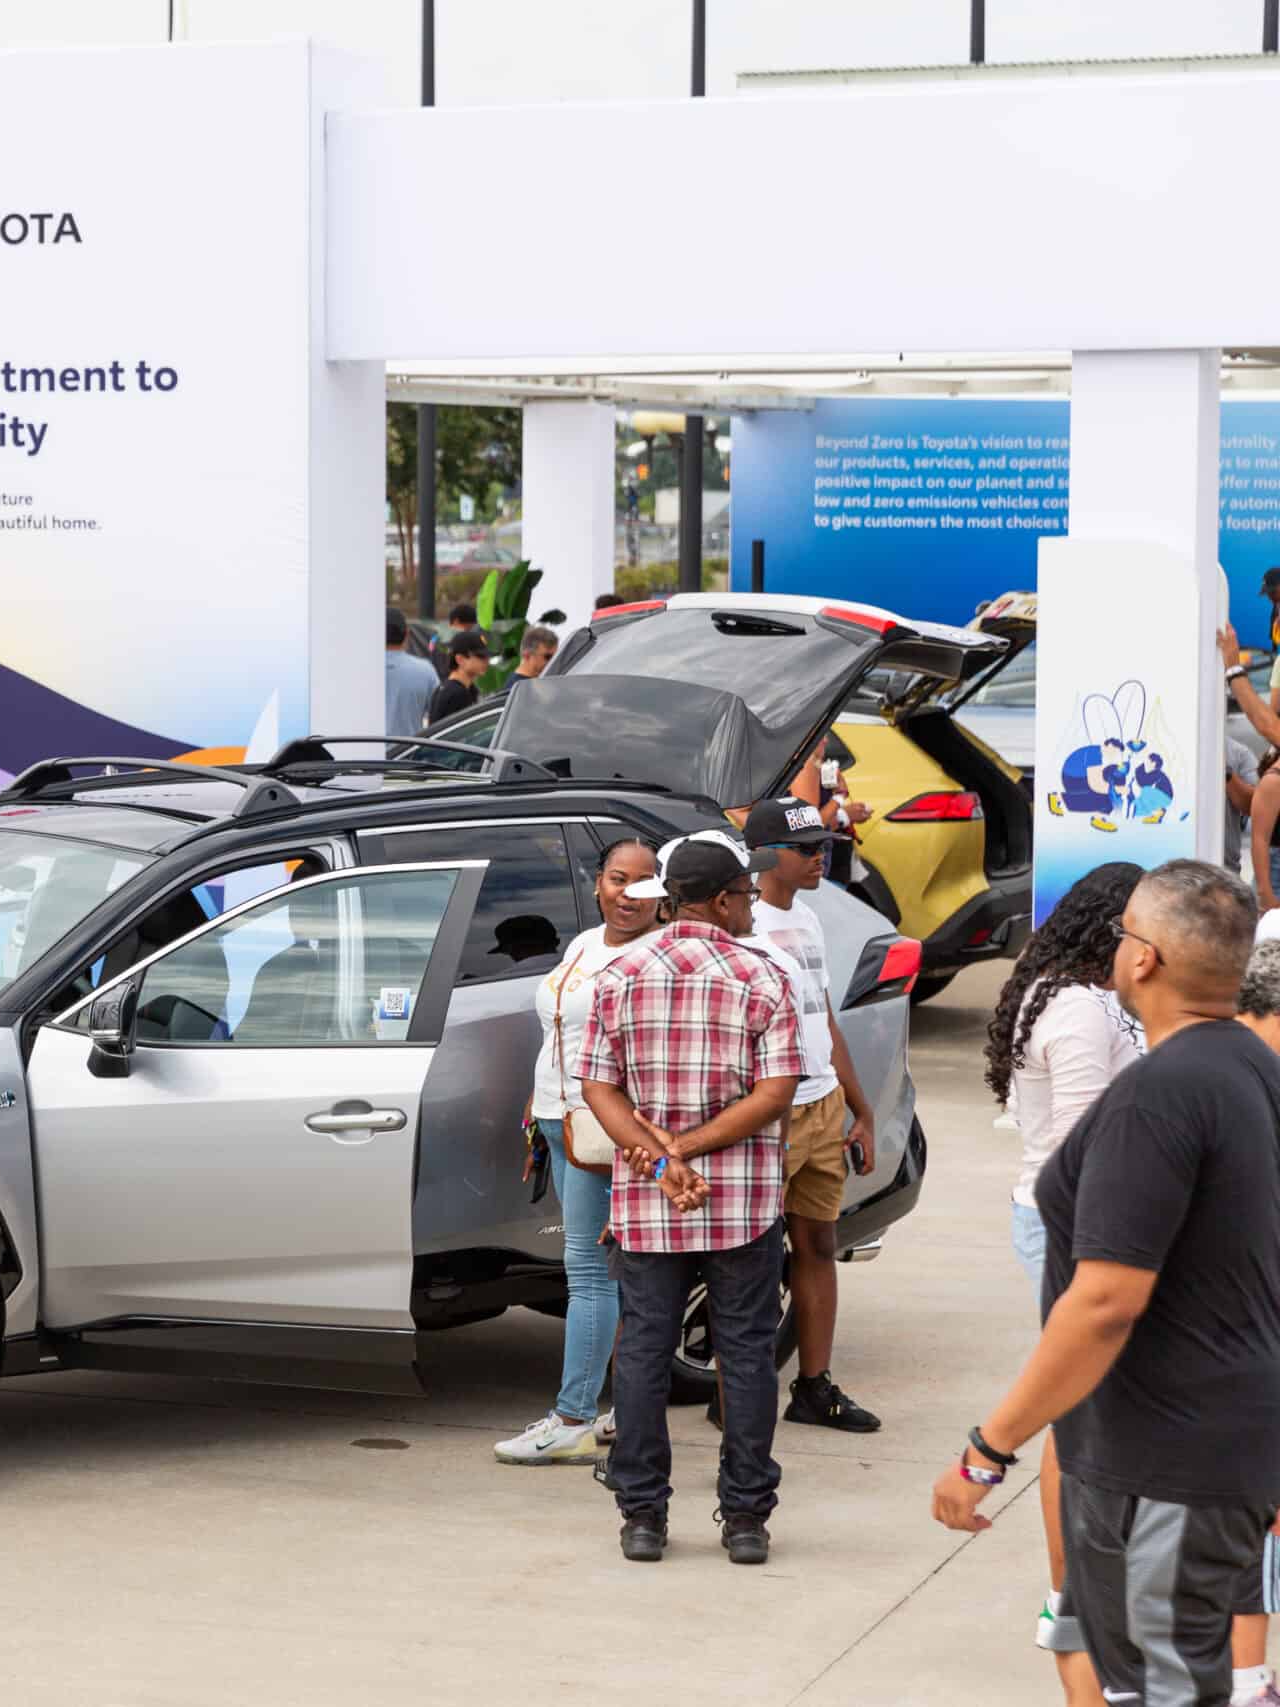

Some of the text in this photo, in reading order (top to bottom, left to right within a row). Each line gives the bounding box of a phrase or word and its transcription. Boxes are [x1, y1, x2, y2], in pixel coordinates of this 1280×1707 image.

[135, 359, 179, 392] to
[815, 434, 868, 452] Beyond
[872, 435, 903, 449] Zero
[907, 434, 918, 449] is
[922, 434, 977, 452] Toyota's
[981, 434, 1024, 449] vision
[1027, 436, 1042, 449] to
[815, 457, 839, 468] our
[842, 455, 910, 471] products,
[914, 455, 975, 471] services,
[978, 455, 1006, 469] and
[815, 474, 870, 491] positive
[874, 474, 923, 491] impact
[926, 477, 944, 489] on
[948, 477, 972, 489] our
[976, 474, 1023, 491] planet
[1026, 474, 1054, 489] and
[814, 493, 839, 508] low
[843, 493, 870, 508] and
[874, 495, 904, 508] zero
[907, 494, 978, 508] emissions
[981, 494, 1039, 508] vehicles
[51, 515, 102, 530] home.
[814, 513, 829, 528] to
[832, 512, 861, 530] give
[864, 514, 937, 529] customers
[941, 512, 964, 529] the
[967, 513, 1003, 529] most
[1006, 513, 1060, 529] choices
